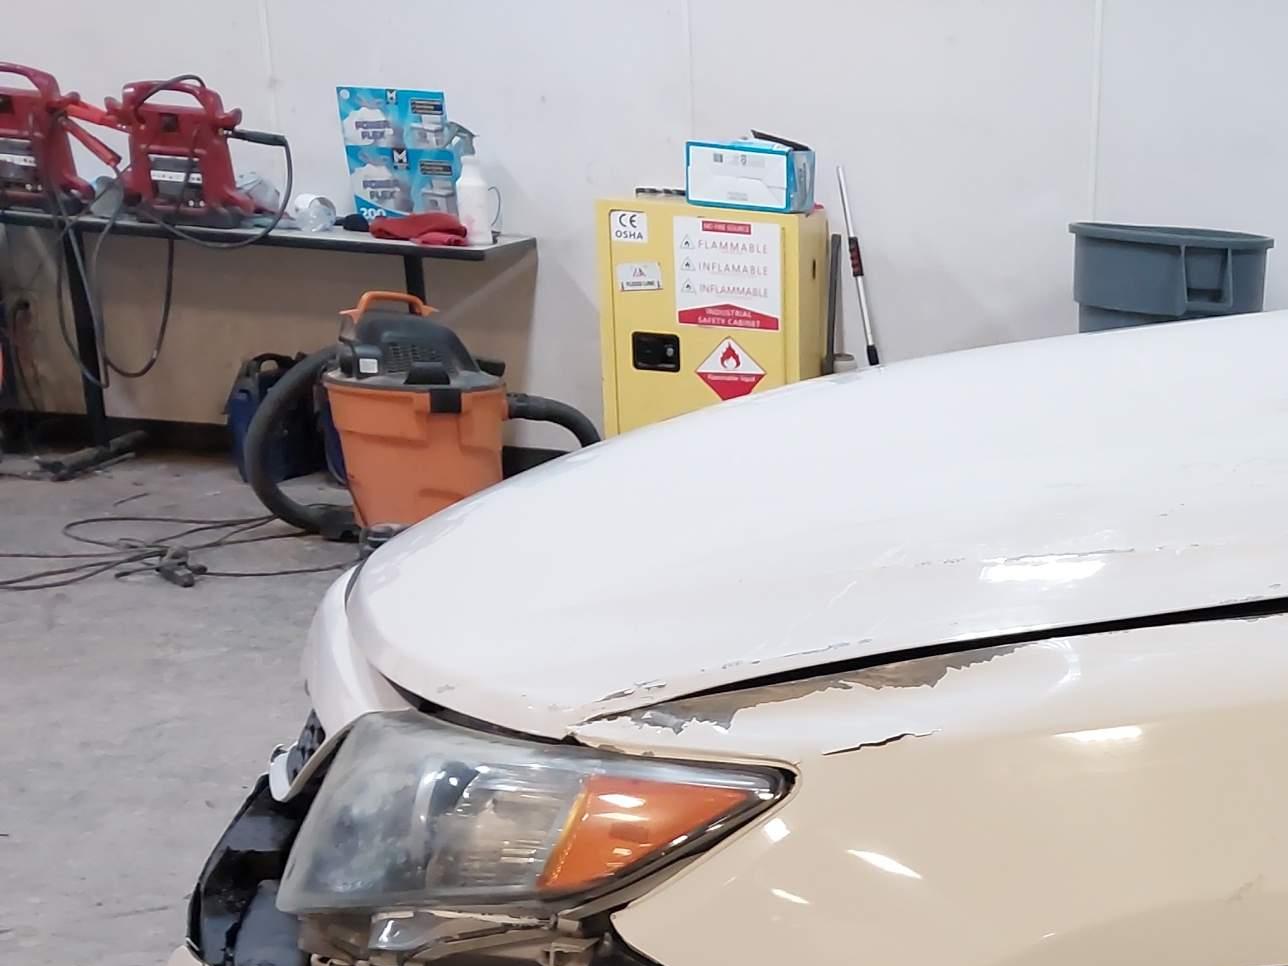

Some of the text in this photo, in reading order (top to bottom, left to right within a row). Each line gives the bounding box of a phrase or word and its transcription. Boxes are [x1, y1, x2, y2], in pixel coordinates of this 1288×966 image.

[615, 230, 644, 240] OSHA
[698, 240, 768, 254] FLAMMABLE
[699, 261, 768, 276] INFLAMABLE
[699, 284, 769, 298] INFLAMMABLE
[705, 307, 752, 318] INDUSTRIAL
[698, 316, 760, 328] SAFETY CABINET
